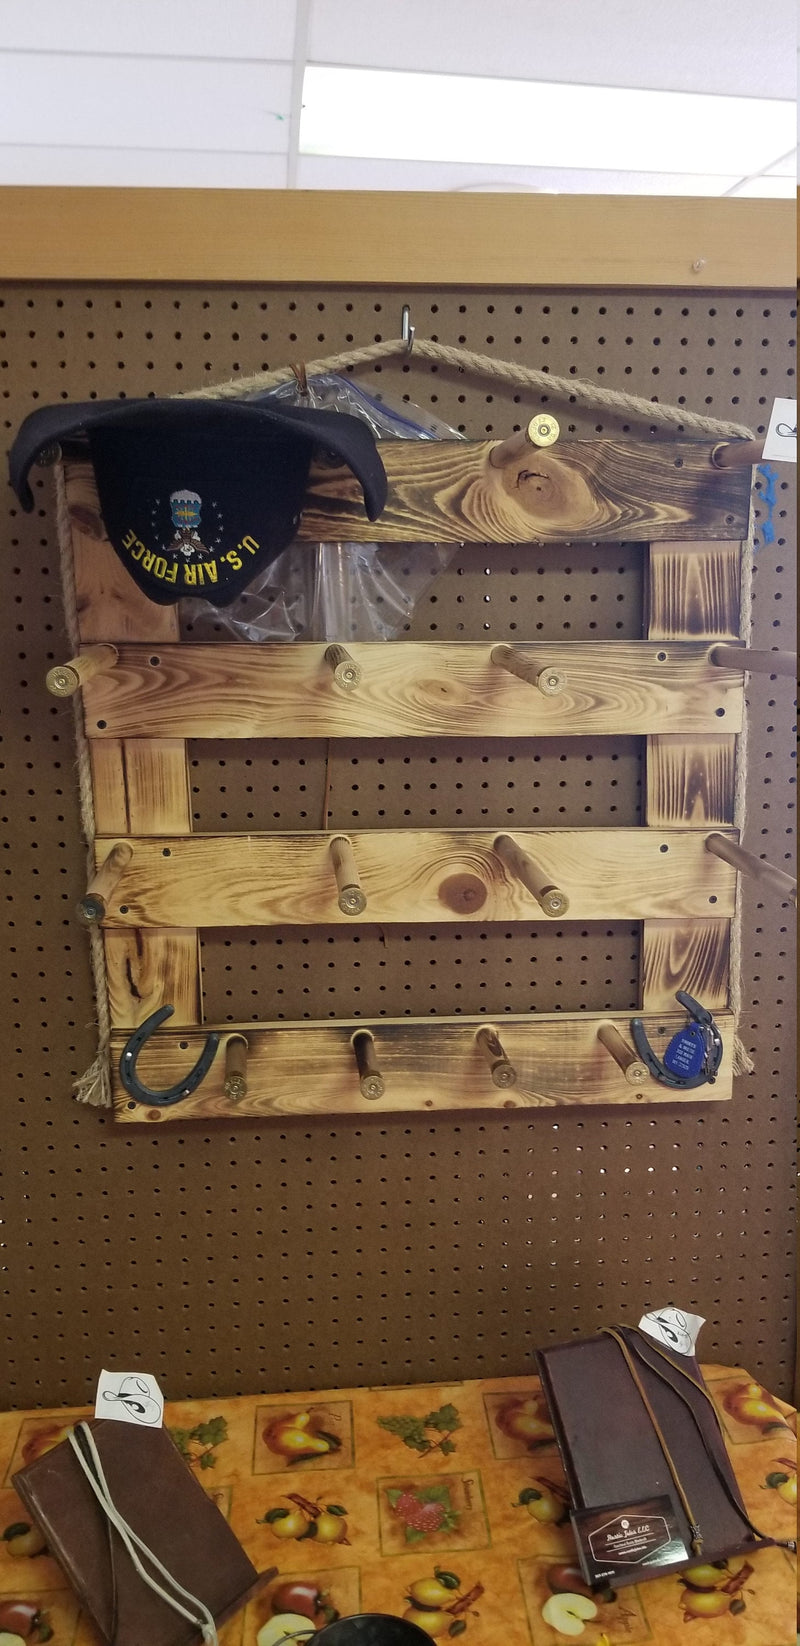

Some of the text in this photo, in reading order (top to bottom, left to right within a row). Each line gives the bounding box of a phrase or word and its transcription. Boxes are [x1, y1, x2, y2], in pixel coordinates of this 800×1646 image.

[121, 528, 260, 586] U.S. AIR FORCE
